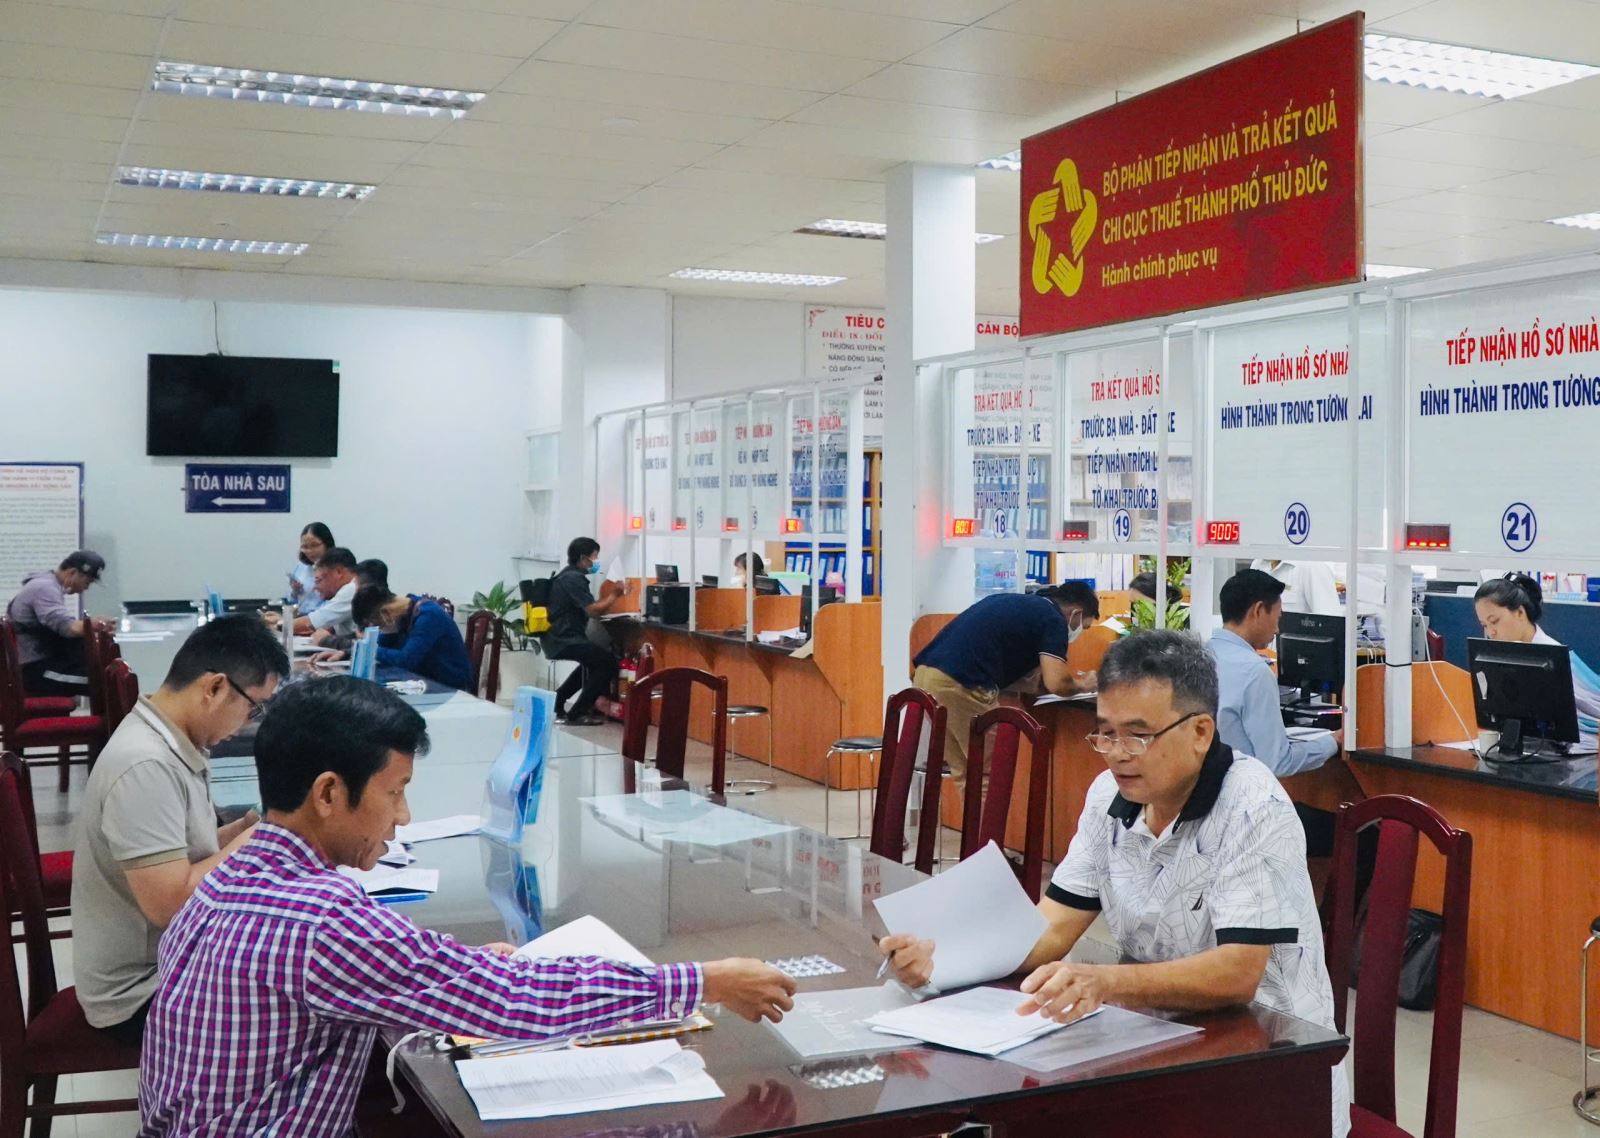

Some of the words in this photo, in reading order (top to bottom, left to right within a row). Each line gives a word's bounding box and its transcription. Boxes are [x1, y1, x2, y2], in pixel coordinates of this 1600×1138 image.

[1103, 161, 1119, 202] BỘ
[1121, 154, 1153, 195] PHẬN
[1154, 138, 1181, 181] TIẾP
[1183, 132, 1218, 176] NHẬN
[1221, 122, 1239, 161] VÀ
[1242, 110, 1270, 155] TRẢ
[1273, 99, 1302, 147] KẾT
[1304, 88, 1338, 137] QUẢ
[1102, 216, 1121, 245] CHI
[1123, 209, 1148, 245] CỤC
[1150, 186, 1182, 233] THUẾ
[1184, 184, 1228, 224] THÀNH
[1231, 164, 1260, 213] PHỐ
[1262, 159, 1292, 205] THỦ
[1295, 153, 1328, 197] ĐỨC
[1102, 261, 1130, 287] Hành
[1133, 253, 1166, 280] chính
[1168, 248, 1199, 279] phục
[1202, 247, 1218, 272] vụ
[976, 321, 1000, 335] CÁN
[1003, 322, 1019, 338] BỘ
[1446, 328, 1476, 366] TIẾP
[1480, 327, 1517, 366] NHẬN
[1521, 317, 1541, 358] HỒ
[1545, 322, 1565, 356] SƠ
[1569, 316, 1599, 354] NHÀ
[1242, 353, 1264, 386] TIẾP
[1266, 353, 1293, 386] NHẬN
[1296, 345, 1310, 379] HỒ
[1313, 349, 1328, 378] SƠ
[1091, 373, 1105, 402] TRẢ
[1107, 371, 1122, 400] KẾT
[1124, 368, 1140, 401] QUẢ
[1142, 366, 1153, 395] HỒ
[1420, 384, 1450, 416] HÌNH
[1453, 379, 1498, 413] THÀNH
[1502, 381, 1549, 411] TRONG
[1552, 373, 1600, 408] TƯƠNG
[1081, 412, 1105, 439] TRƯỚC
[1106, 417, 1117, 441] BẠ
[1119, 410, 1134, 436] NHÀ
[1141, 405, 1157, 435] ĐẤT
[1221, 402, 1243, 430] HÌNH
[1245, 399, 1277, 428] THÀNH
[1281, 400, 1314, 425] TRONG
[1358, 395, 1373, 420] AI
[1032, 423, 1041, 442] XE
[1087, 446, 1104, 474] TIẾP
[1105, 448, 1126, 477] NHẬN
[1127, 446, 1151, 472] TRÍCH
[191, 472, 220, 491] TÒA
[224, 472, 254, 491] NHÀ
[257, 475, 286, 491] SAU
[1092, 484, 1102, 509] TỜ
[1104, 489, 1121, 509] KHAI
[1123, 483, 1149, 509] TRƯỚC
[995, 515, 1006, 533] 18
[1115, 515, 1130, 537] 19
[1210, 523, 1239, 540] 9005
[1287, 511, 1307, 535] 20
[1506, 512, 1531, 542] 21
